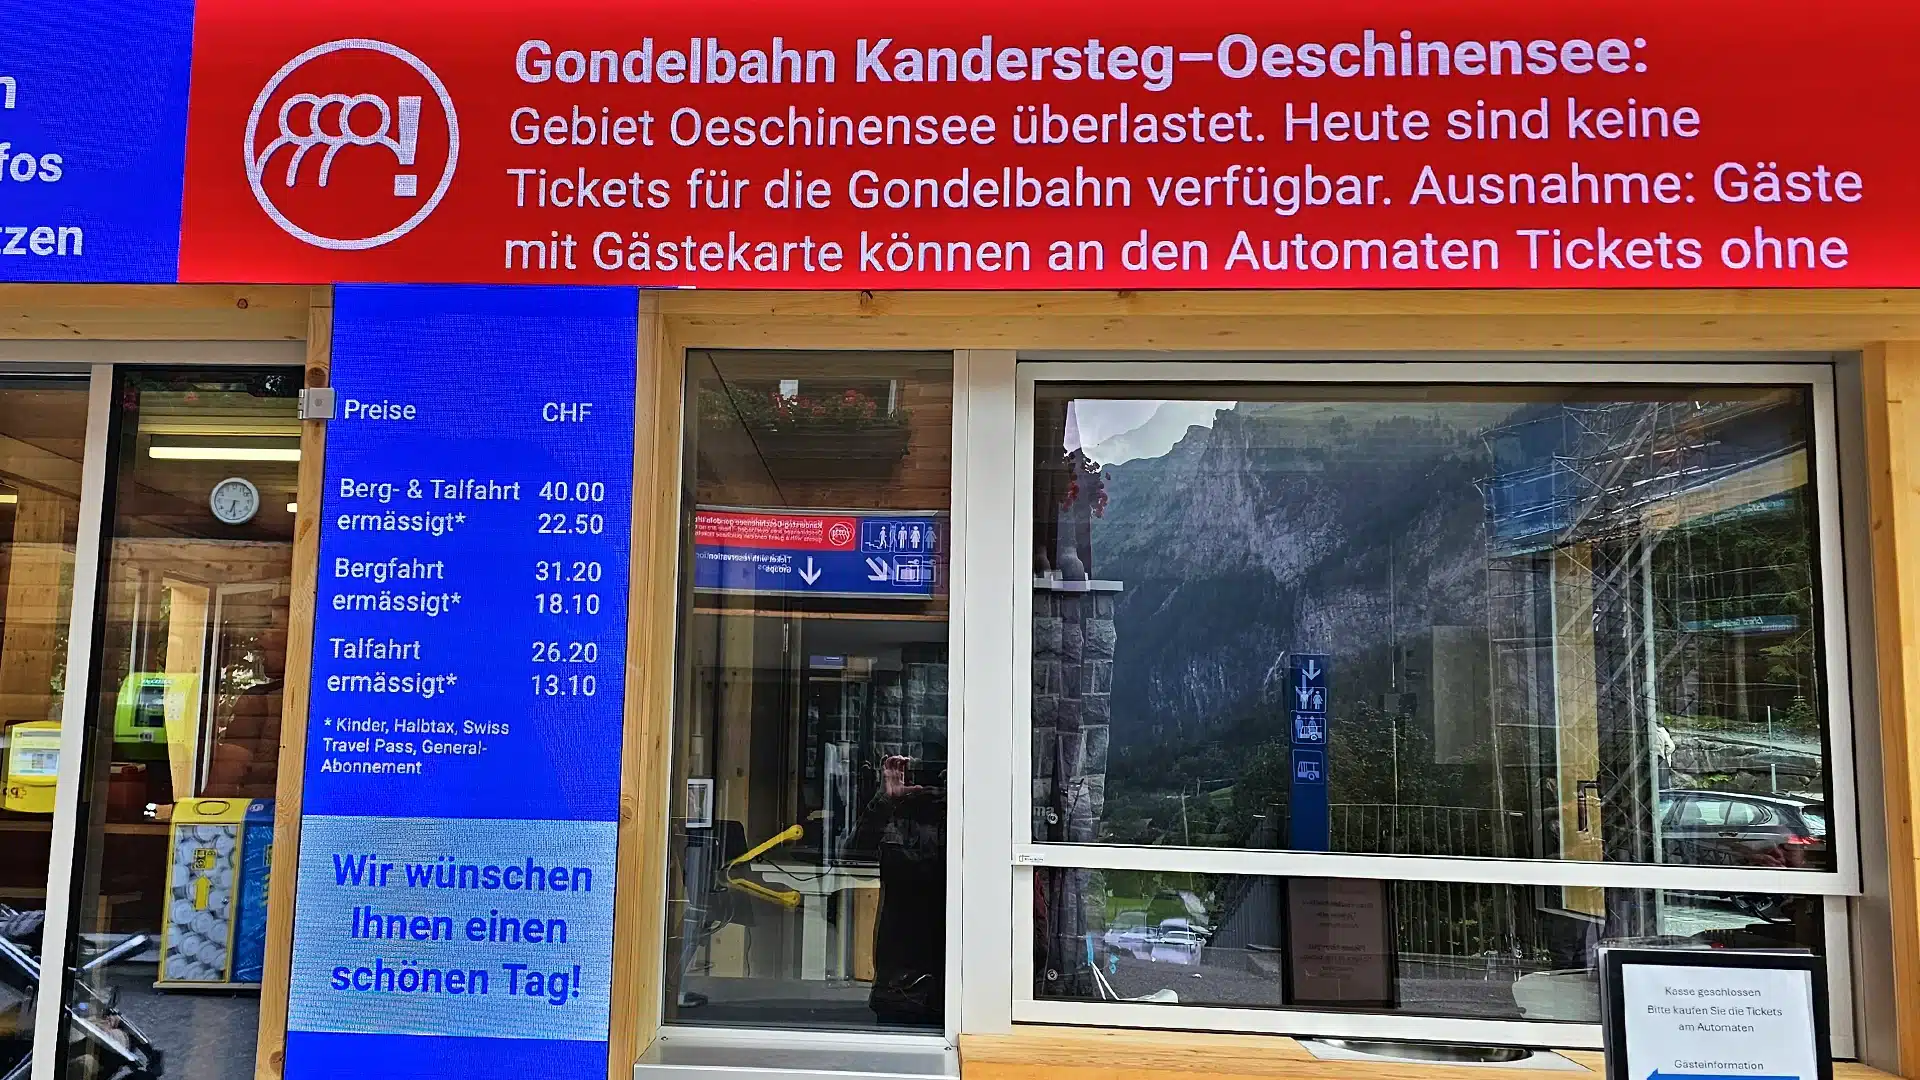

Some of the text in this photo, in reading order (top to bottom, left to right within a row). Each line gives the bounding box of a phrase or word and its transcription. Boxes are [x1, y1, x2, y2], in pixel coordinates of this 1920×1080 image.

[516, 37, 835, 83] Gondelbahn
[511, 98, 1700, 147] Gebiet Oeschinensee überlastet. Heute sind keine
[507, 161, 1863, 215] Tickets für die Gondelbahn verfügbar. Ausnahme: Gäste
[505, 226, 1849, 272] mit Gästekarte können an den Automaten Tickets ohne
[344, 399, 593, 423] Preise CHF
[340, 478, 605, 504] Berg- & Talfahrt 40.00
[538, 513, 604, 535] 22.50
[335, 557, 602, 583] Bergfahrt 31.20
[535, 593, 600, 615] 18.10
[329, 638, 598, 663] Talfahrt 26.20
[532, 674, 596, 697] 13.10
[336, 717, 389, 734] Kinder,
[394, 718, 458, 735] Halbtax,
[463, 719, 509, 735] Swiss
[323, 737, 488, 756] Travel Pass, General-
[320, 757, 423, 775] Abonnement
[332, 853, 592, 892] Wir wünschen
[351, 905, 568, 944] Ihnen einen
[330, 958, 581, 1006] schönen Tag!
[1664, 986, 1762, 998] Kasse geschlossen
[1647, 1005, 1783, 1017] Bitte kaufen Sie die Tickets
[1678, 1022, 1755, 1033] am Automaten
